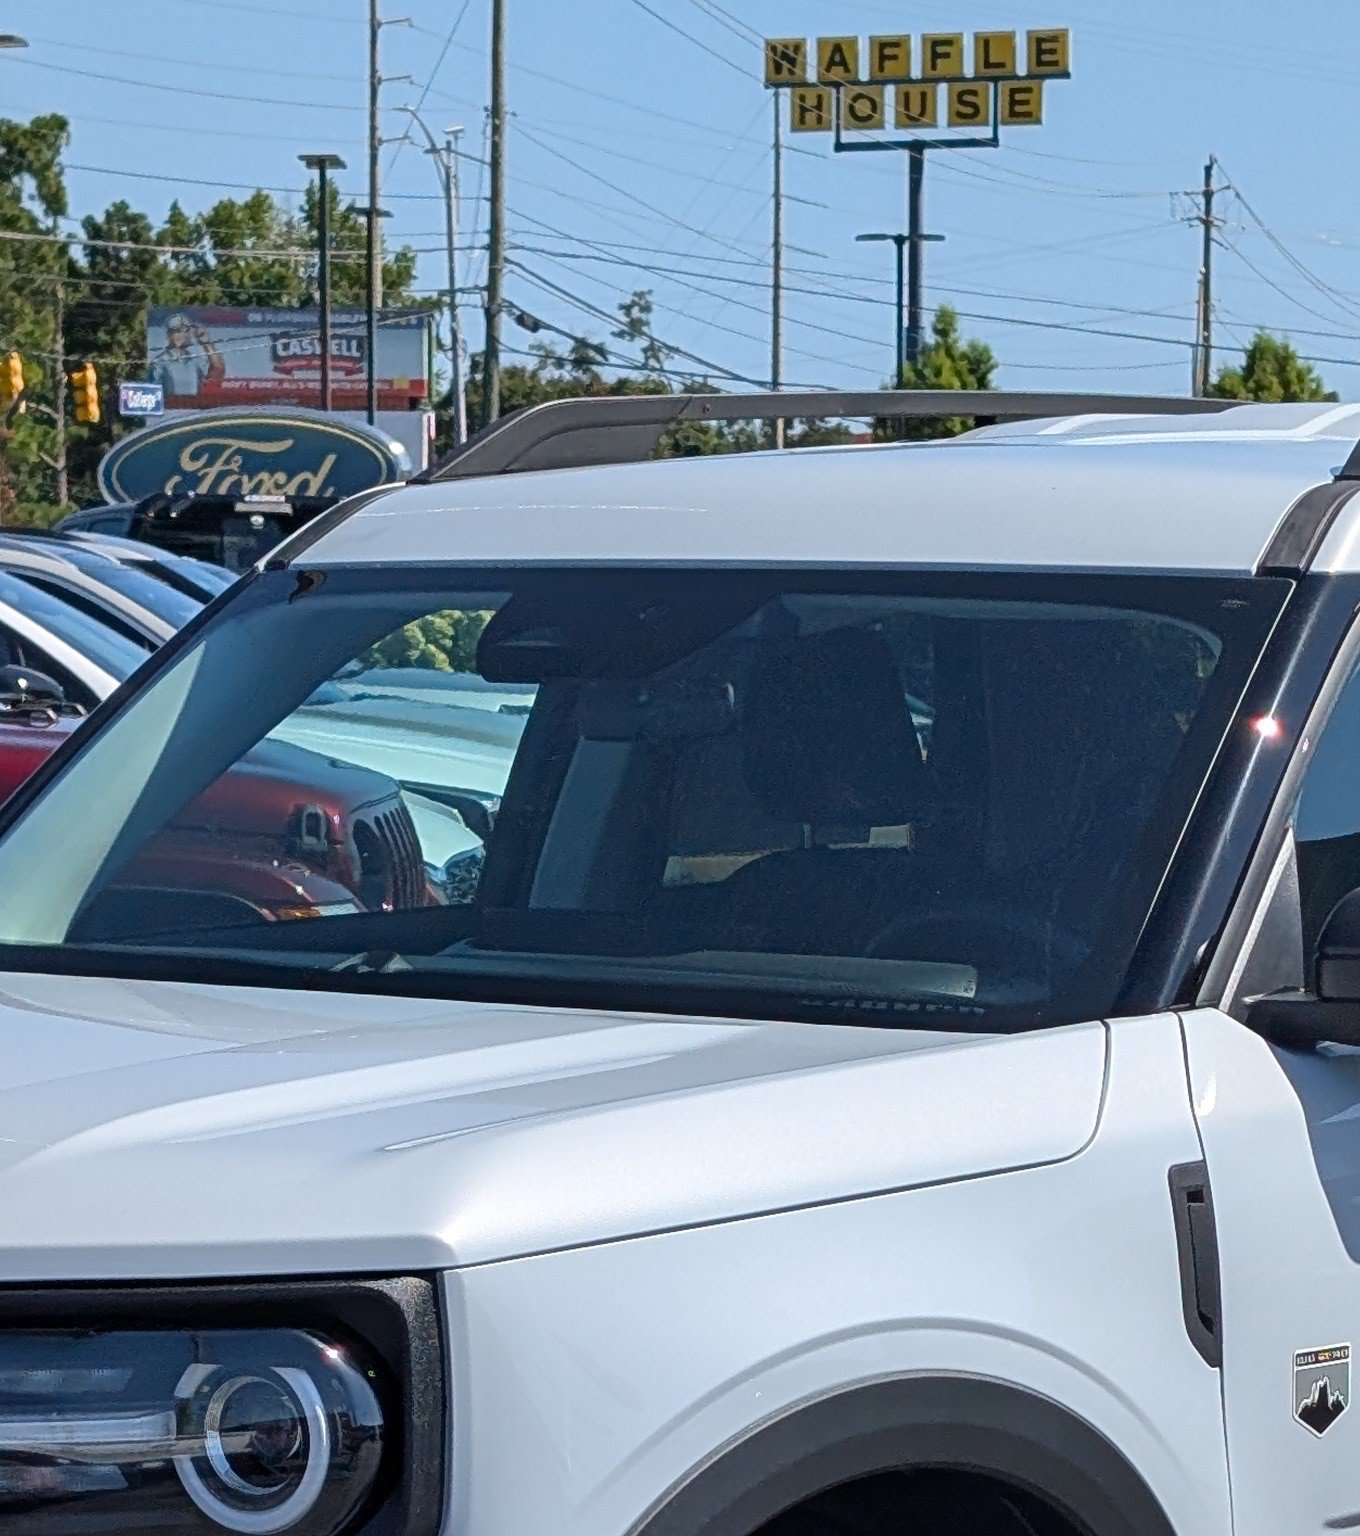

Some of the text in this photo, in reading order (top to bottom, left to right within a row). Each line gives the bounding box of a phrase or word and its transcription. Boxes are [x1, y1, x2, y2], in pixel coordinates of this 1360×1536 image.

[769, 35, 1061, 77] WAFFLE
[797, 86, 1034, 126] HOUSE
[275, 337, 362, 357] CASELL
[165, 438, 334, 496] Ford
